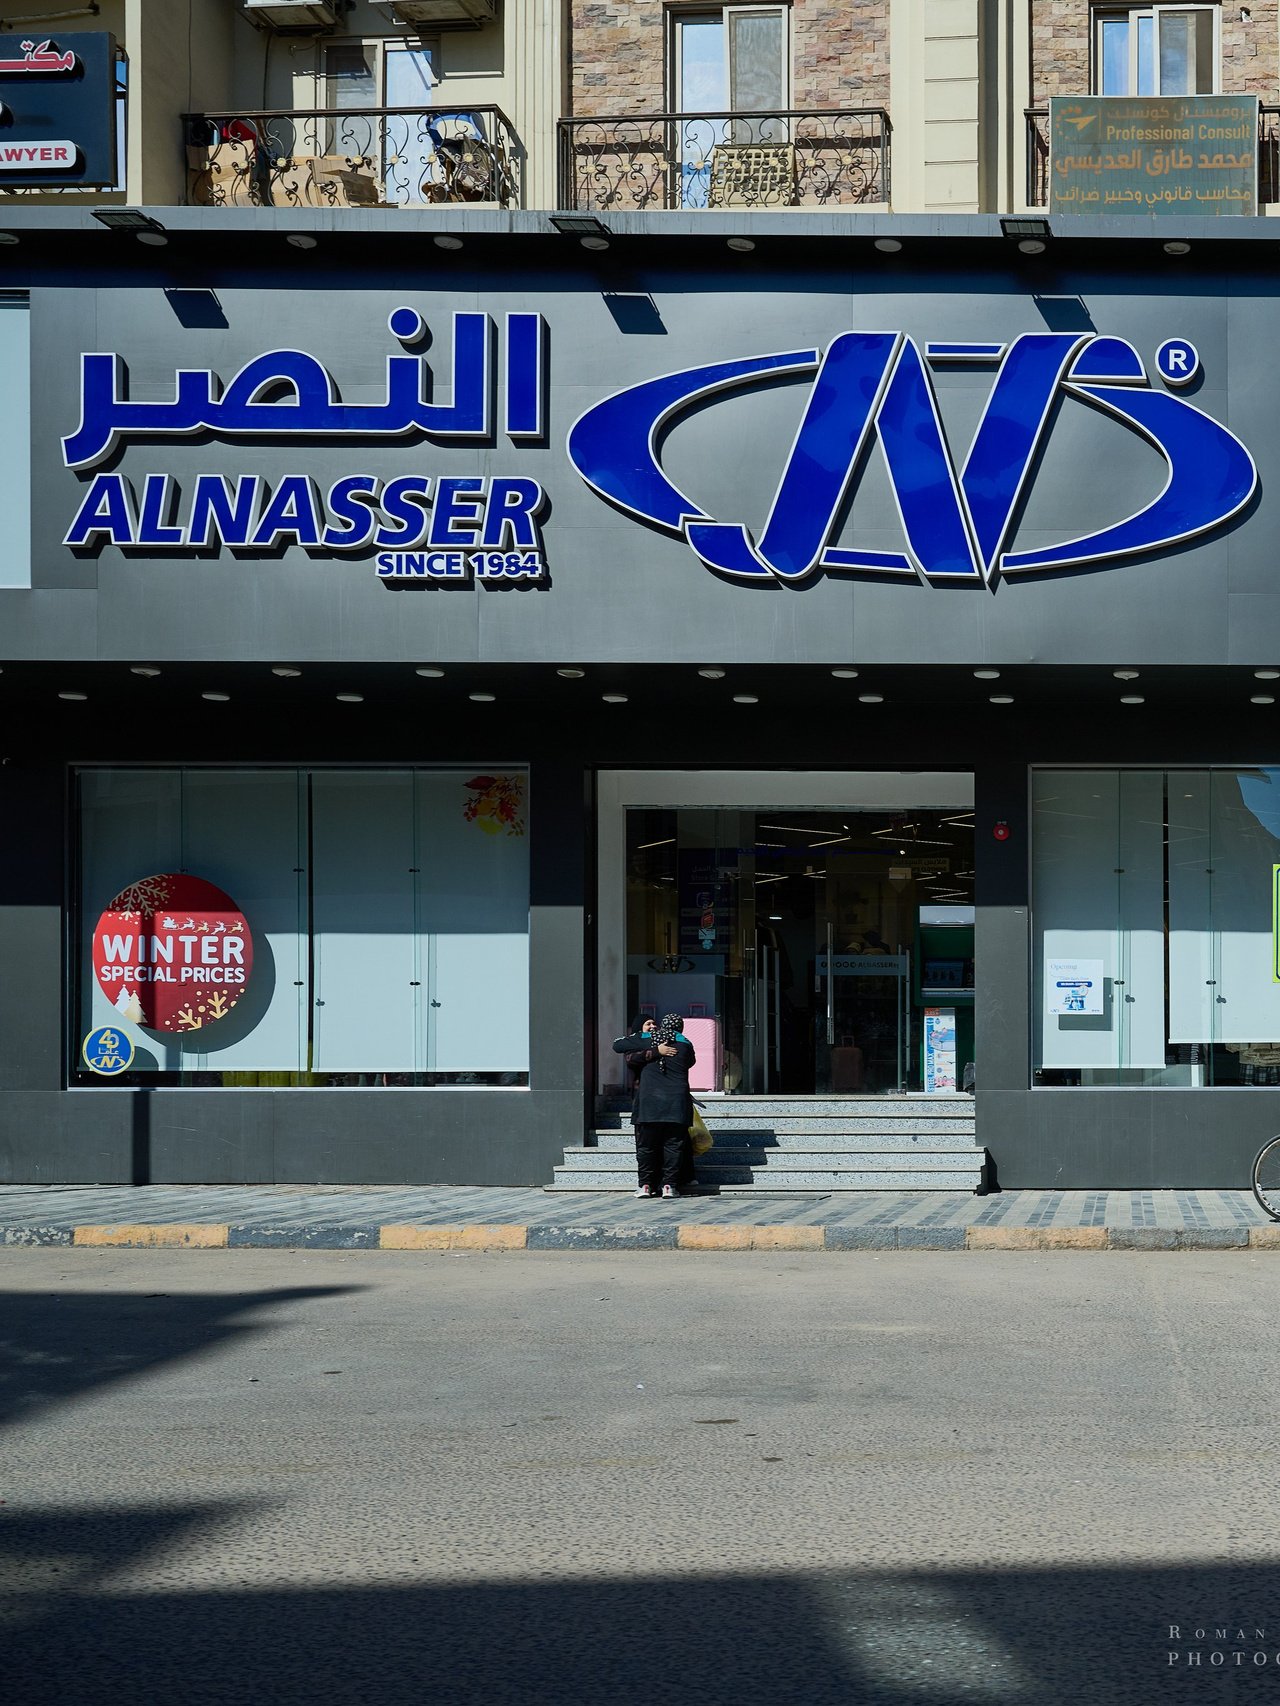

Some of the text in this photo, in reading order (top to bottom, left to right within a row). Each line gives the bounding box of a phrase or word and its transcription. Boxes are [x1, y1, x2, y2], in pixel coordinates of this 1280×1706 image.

[1107, 124, 1251, 141] Professional Consult
[1146, 149, 1193, 176] طارق
[1198, 153, 1251, 170] محمد
[1055, 186, 1251, 208] محاسب قانوني وخبير ضرائب
[61, 306, 543, 469] النصر
[62, 473, 543, 549] ALNASSER
[376, 551, 543, 579] SINCE 1984
[102, 933, 245, 965] WINTER
[101, 965, 246, 983] SPECIAL PRICES
